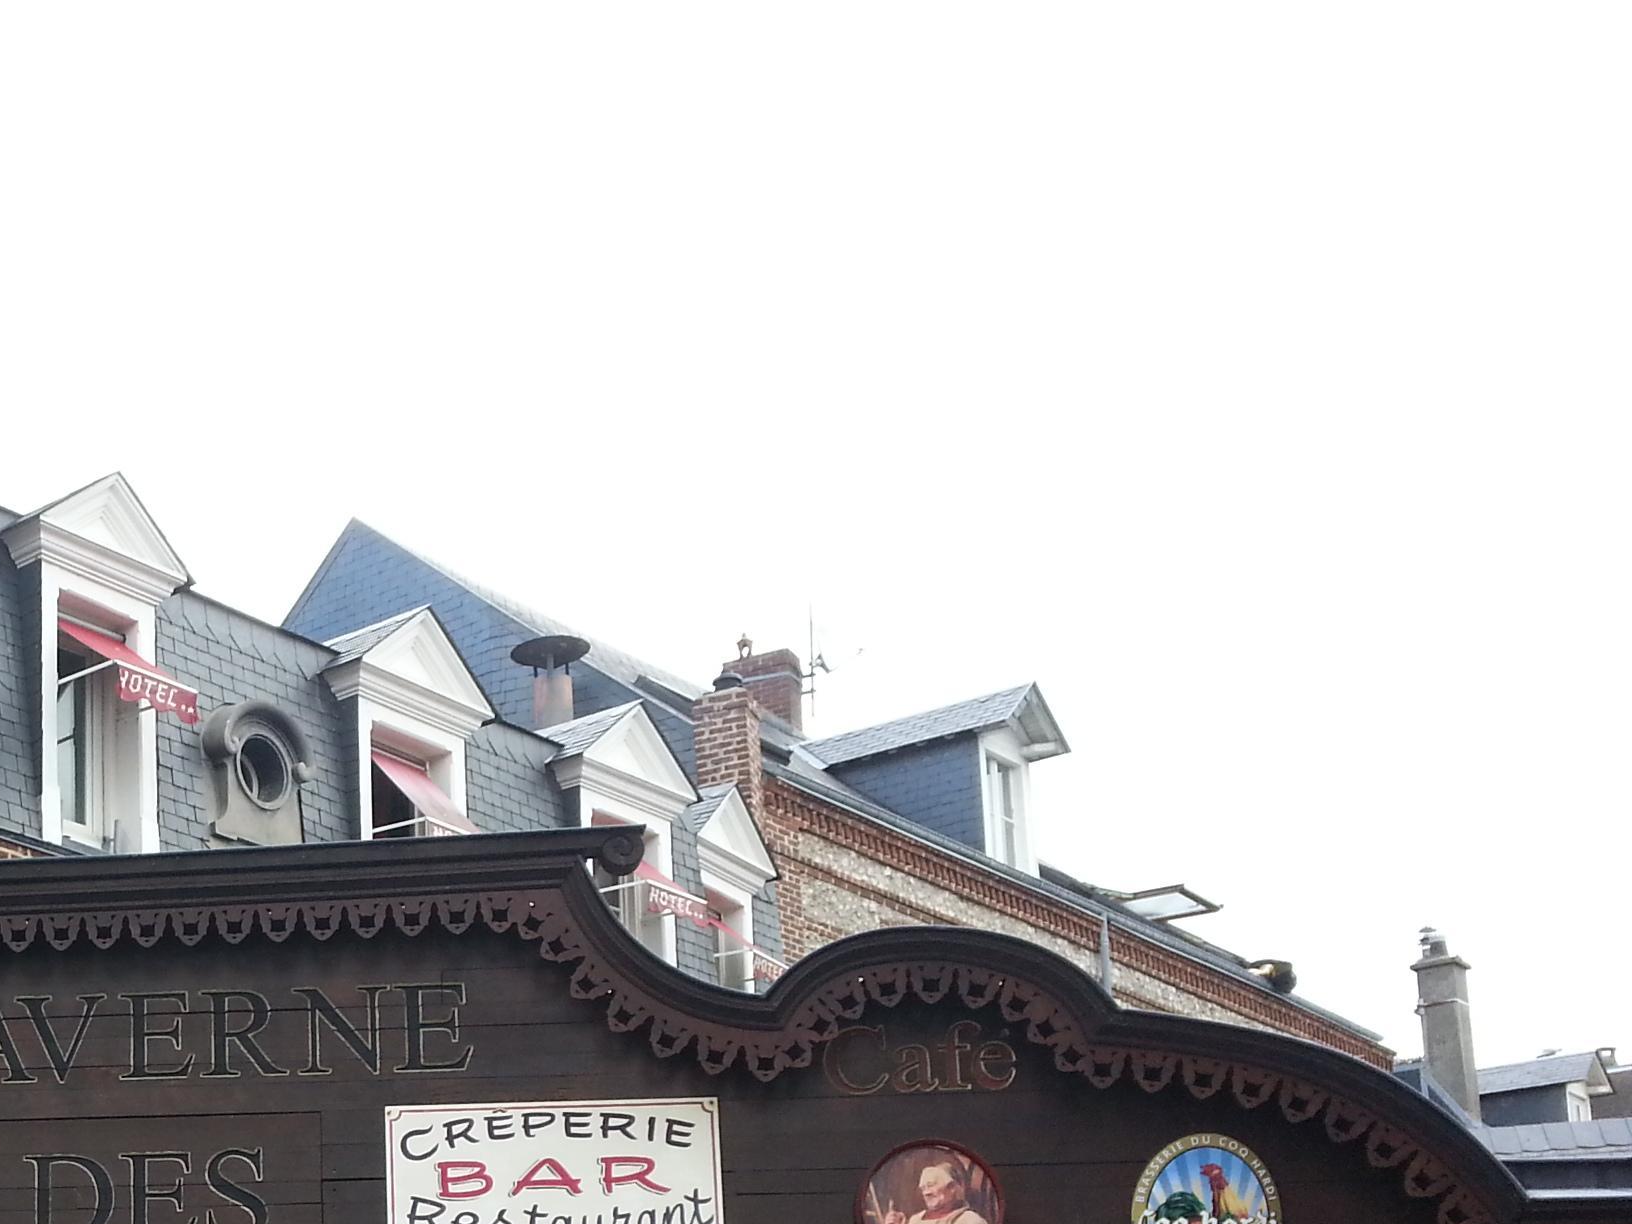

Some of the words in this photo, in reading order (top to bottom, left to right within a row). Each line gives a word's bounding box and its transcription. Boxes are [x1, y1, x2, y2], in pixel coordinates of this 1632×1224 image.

[649, 886, 694, 916] HOTEL
[399, 1108, 696, 1162] CRÊPERIE
[435, 1156, 672, 1200] BAR
[1135, 1140, 1185, 1203] BRASSERIE
[1191, 1136, 1211, 1146] DU
[1219, 1137, 1249, 1158] COQ
[1251, 1160, 1277, 1202] HARDI
